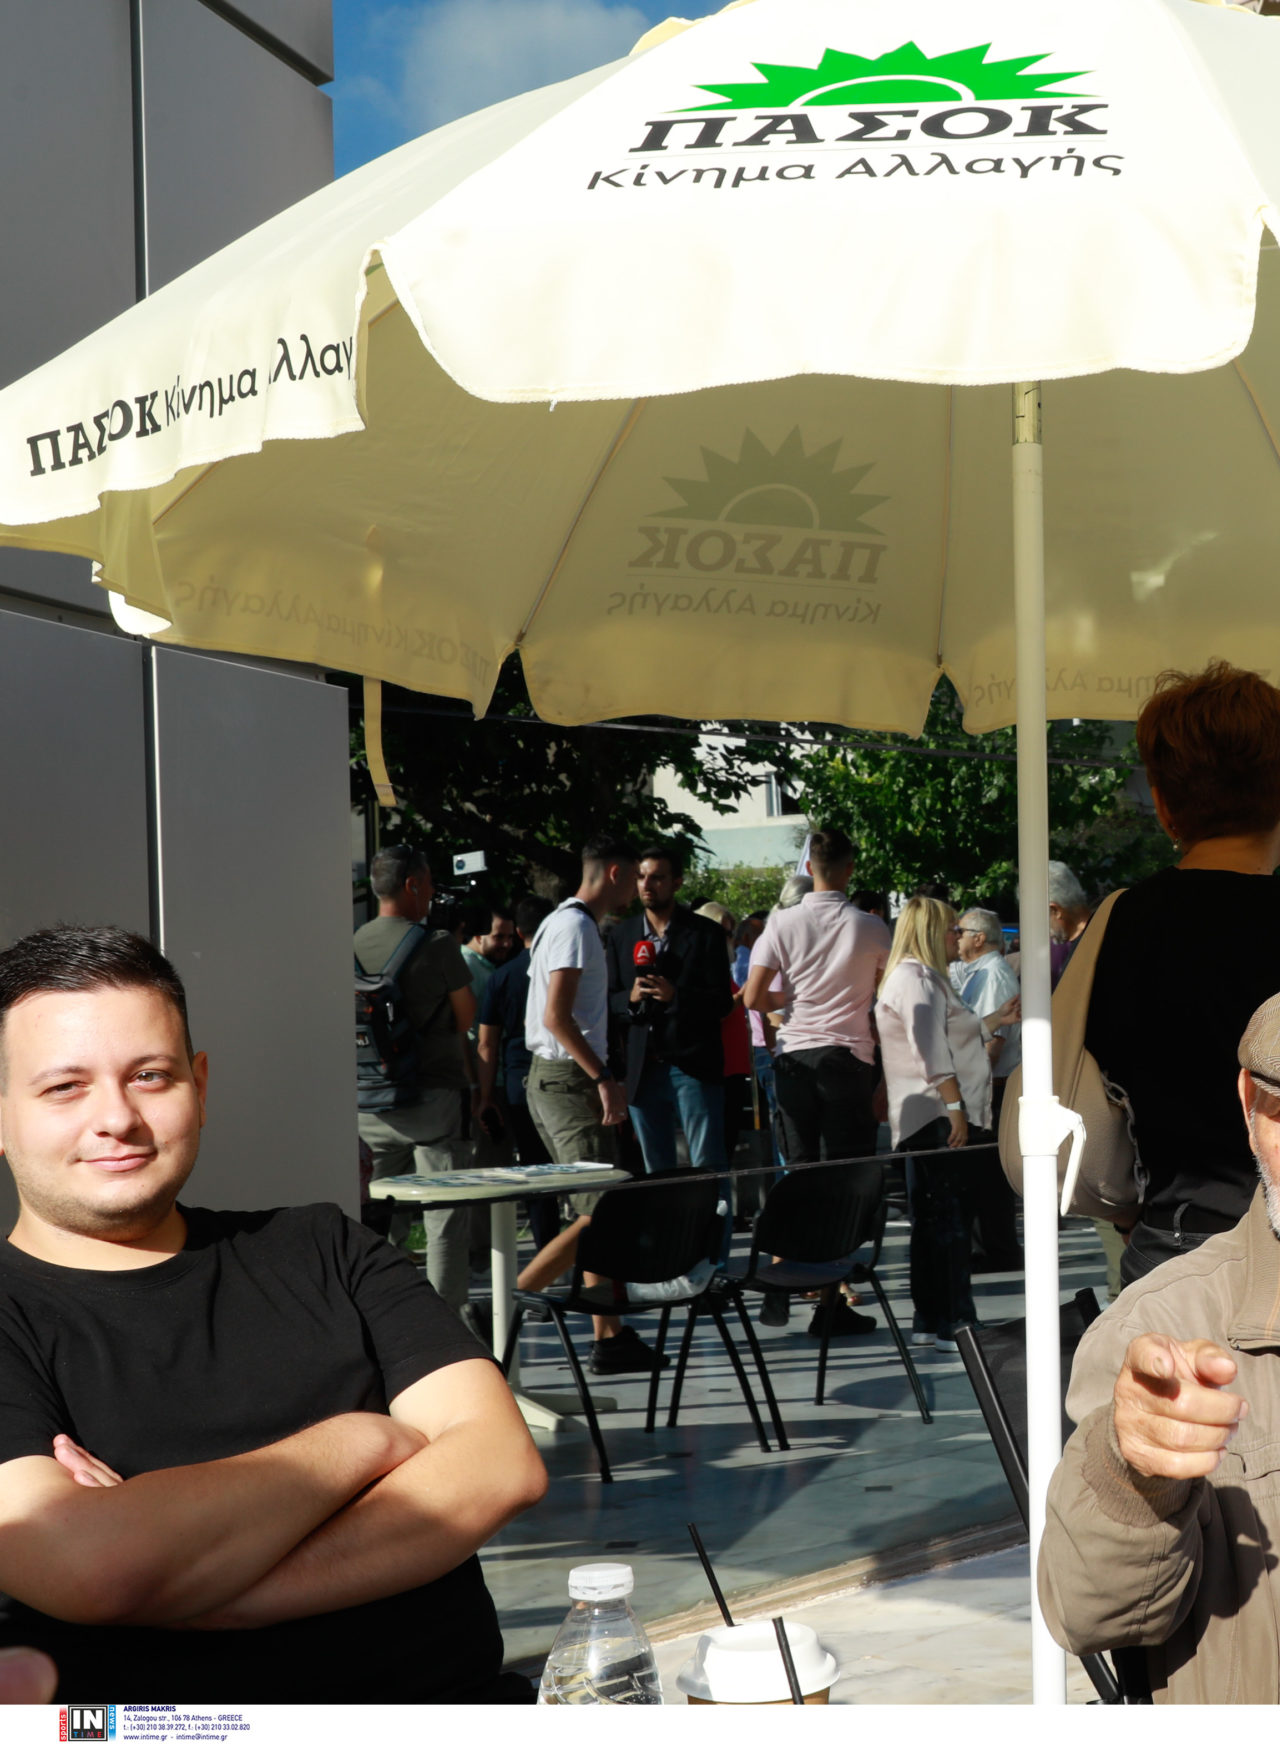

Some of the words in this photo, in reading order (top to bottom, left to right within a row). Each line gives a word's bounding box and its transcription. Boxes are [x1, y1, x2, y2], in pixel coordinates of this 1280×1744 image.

[628, 103, 1109, 152] ΠΑΣΟΚ
[587, 163, 816, 190] Κίνημα
[835, 148, 1126, 179] Αλλαγής
[26, 390, 162, 477] ΠΑΣΟΚ
[164, 367, 258, 427] Κίνημα
[268, 333, 353, 385] λλαγ
[637, 945, 649, 958] A
